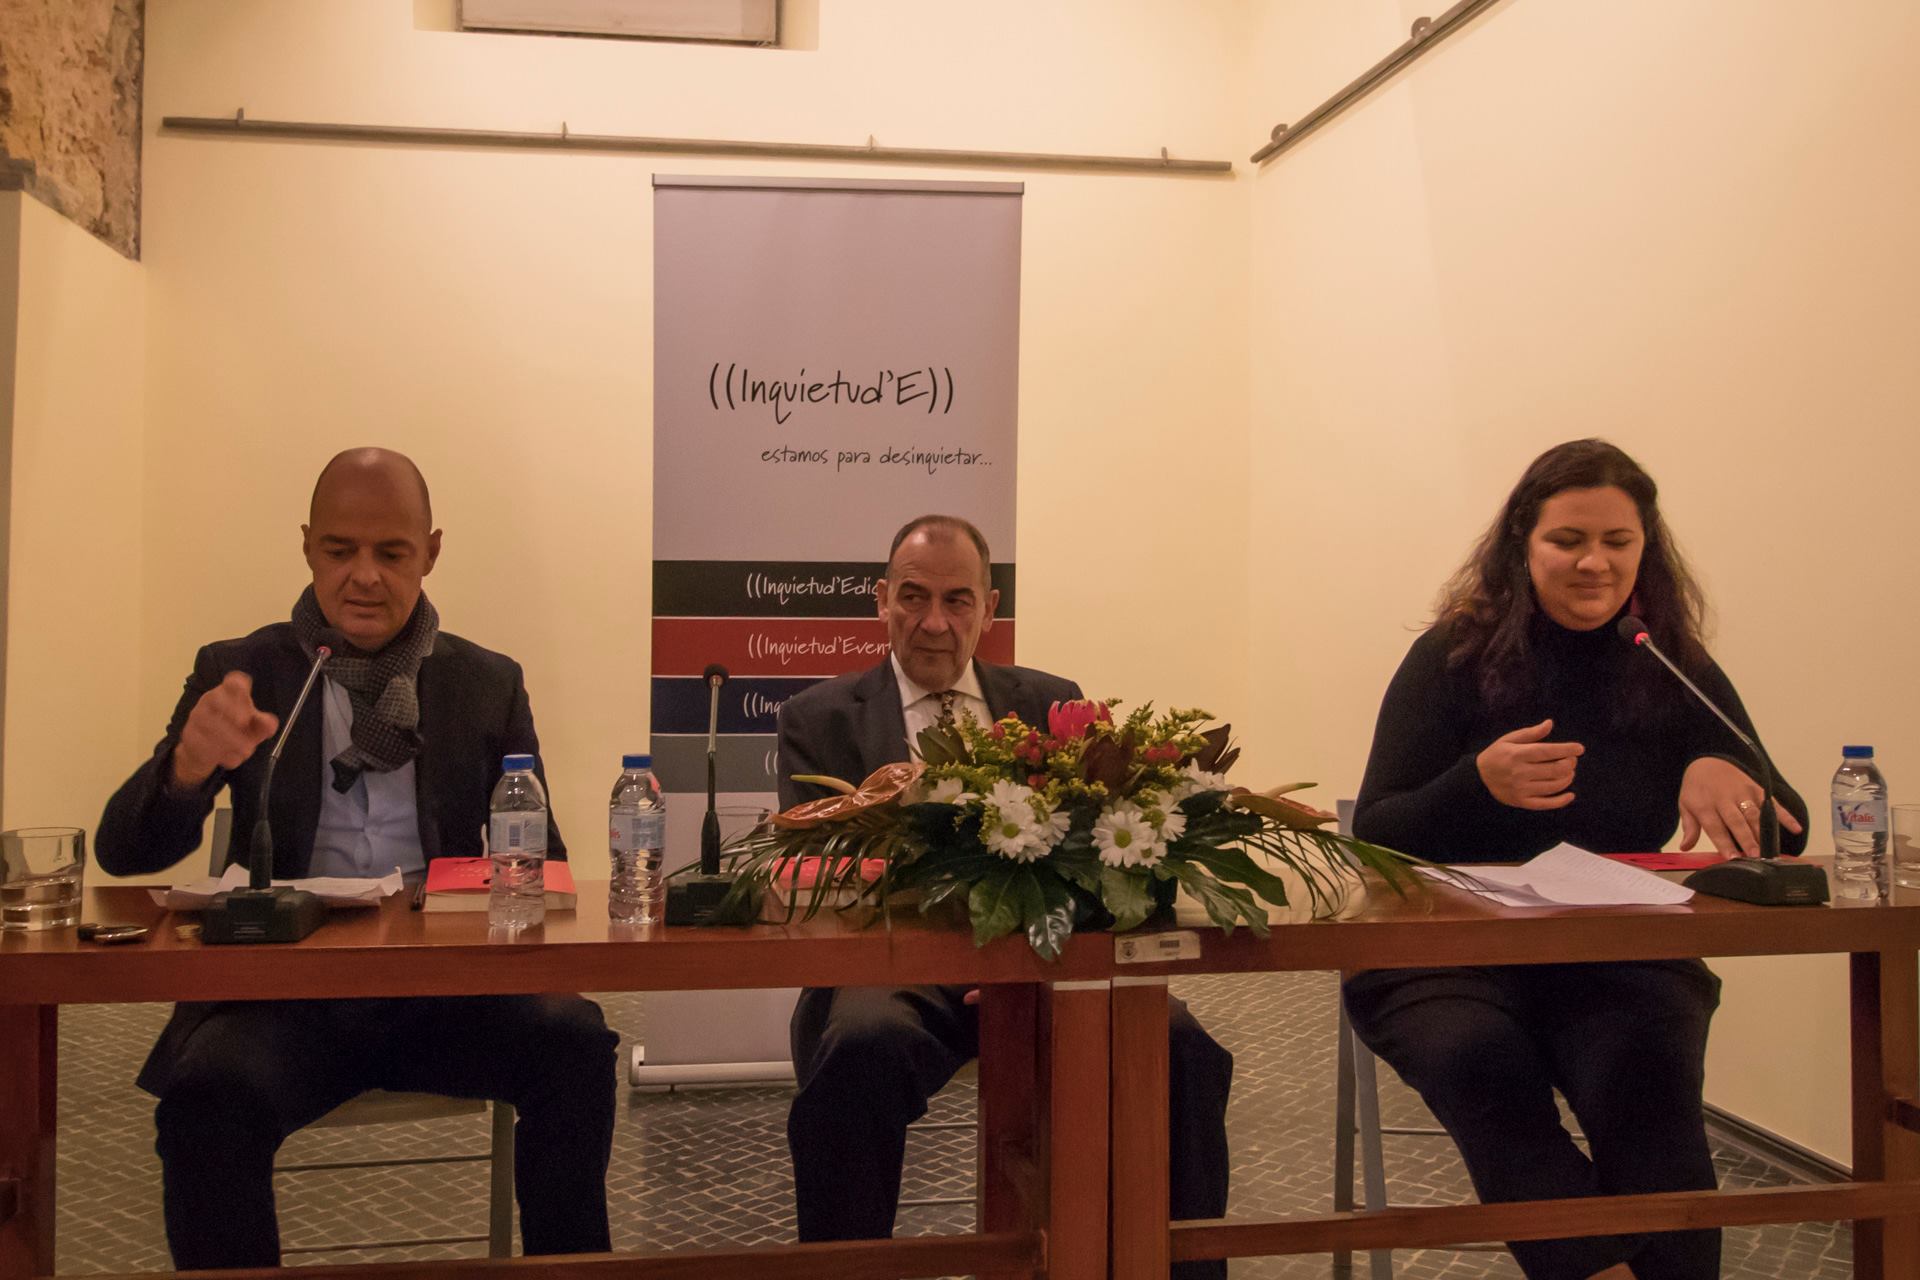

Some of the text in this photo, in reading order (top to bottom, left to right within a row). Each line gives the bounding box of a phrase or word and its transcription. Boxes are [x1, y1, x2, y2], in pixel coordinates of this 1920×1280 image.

[709, 362, 954, 424] ((Inquietud'E))
[761, 445, 993, 475] estamos para desinquietar...
